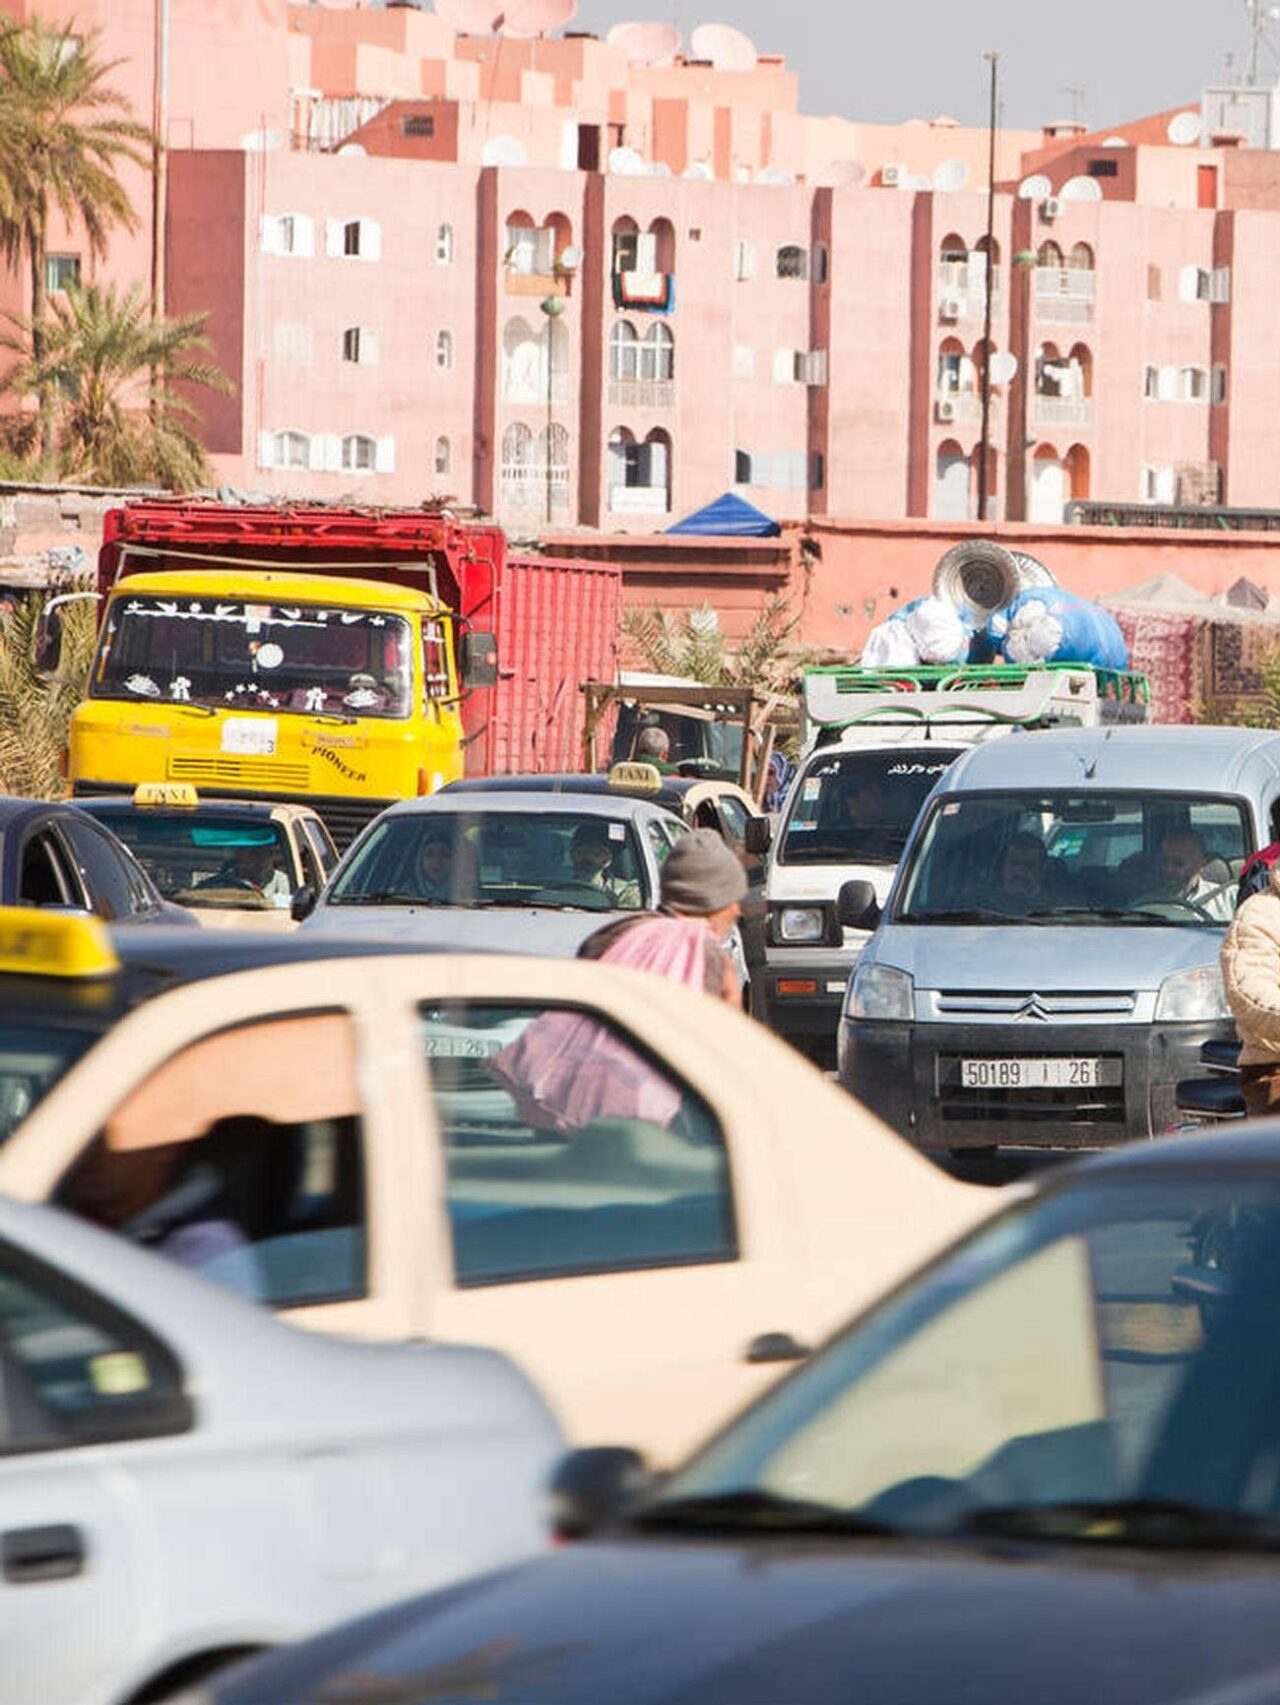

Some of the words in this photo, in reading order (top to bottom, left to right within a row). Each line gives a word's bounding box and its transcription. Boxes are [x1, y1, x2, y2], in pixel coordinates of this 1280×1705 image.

[312, 746, 367, 782] PIONEER
[966, 1062, 1021, 1085] 50189
[1068, 1061, 1090, 1084] 26
